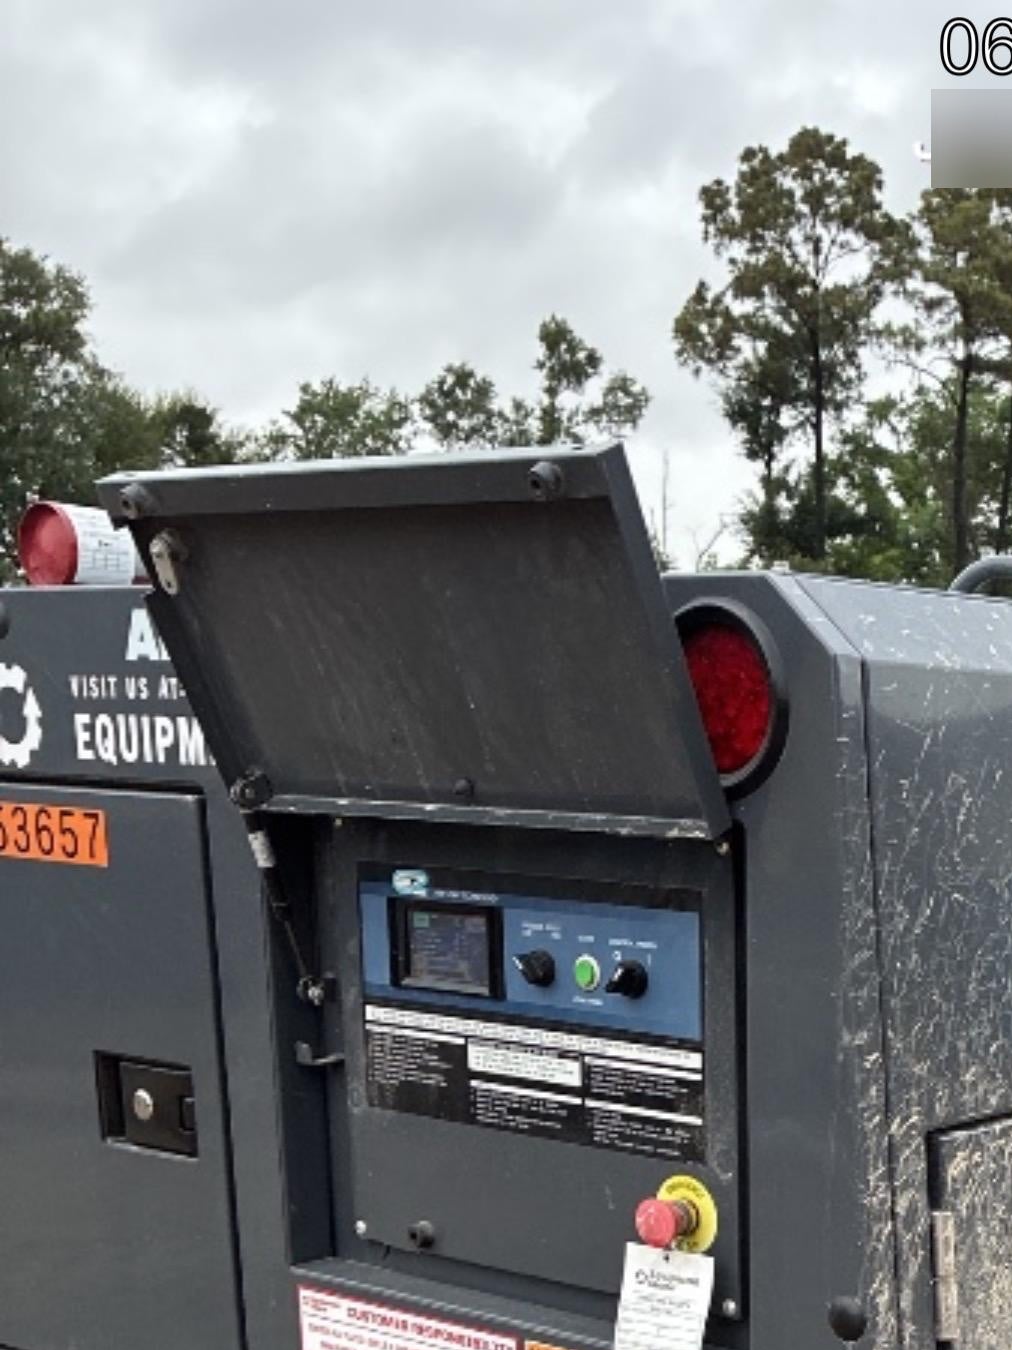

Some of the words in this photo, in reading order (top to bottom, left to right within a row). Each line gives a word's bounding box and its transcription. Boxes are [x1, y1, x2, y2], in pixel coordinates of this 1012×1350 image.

[69, 674, 118, 700] VISIT
[125, 676, 148, 700] US
[74, 712, 217, 767] EQUIPM
